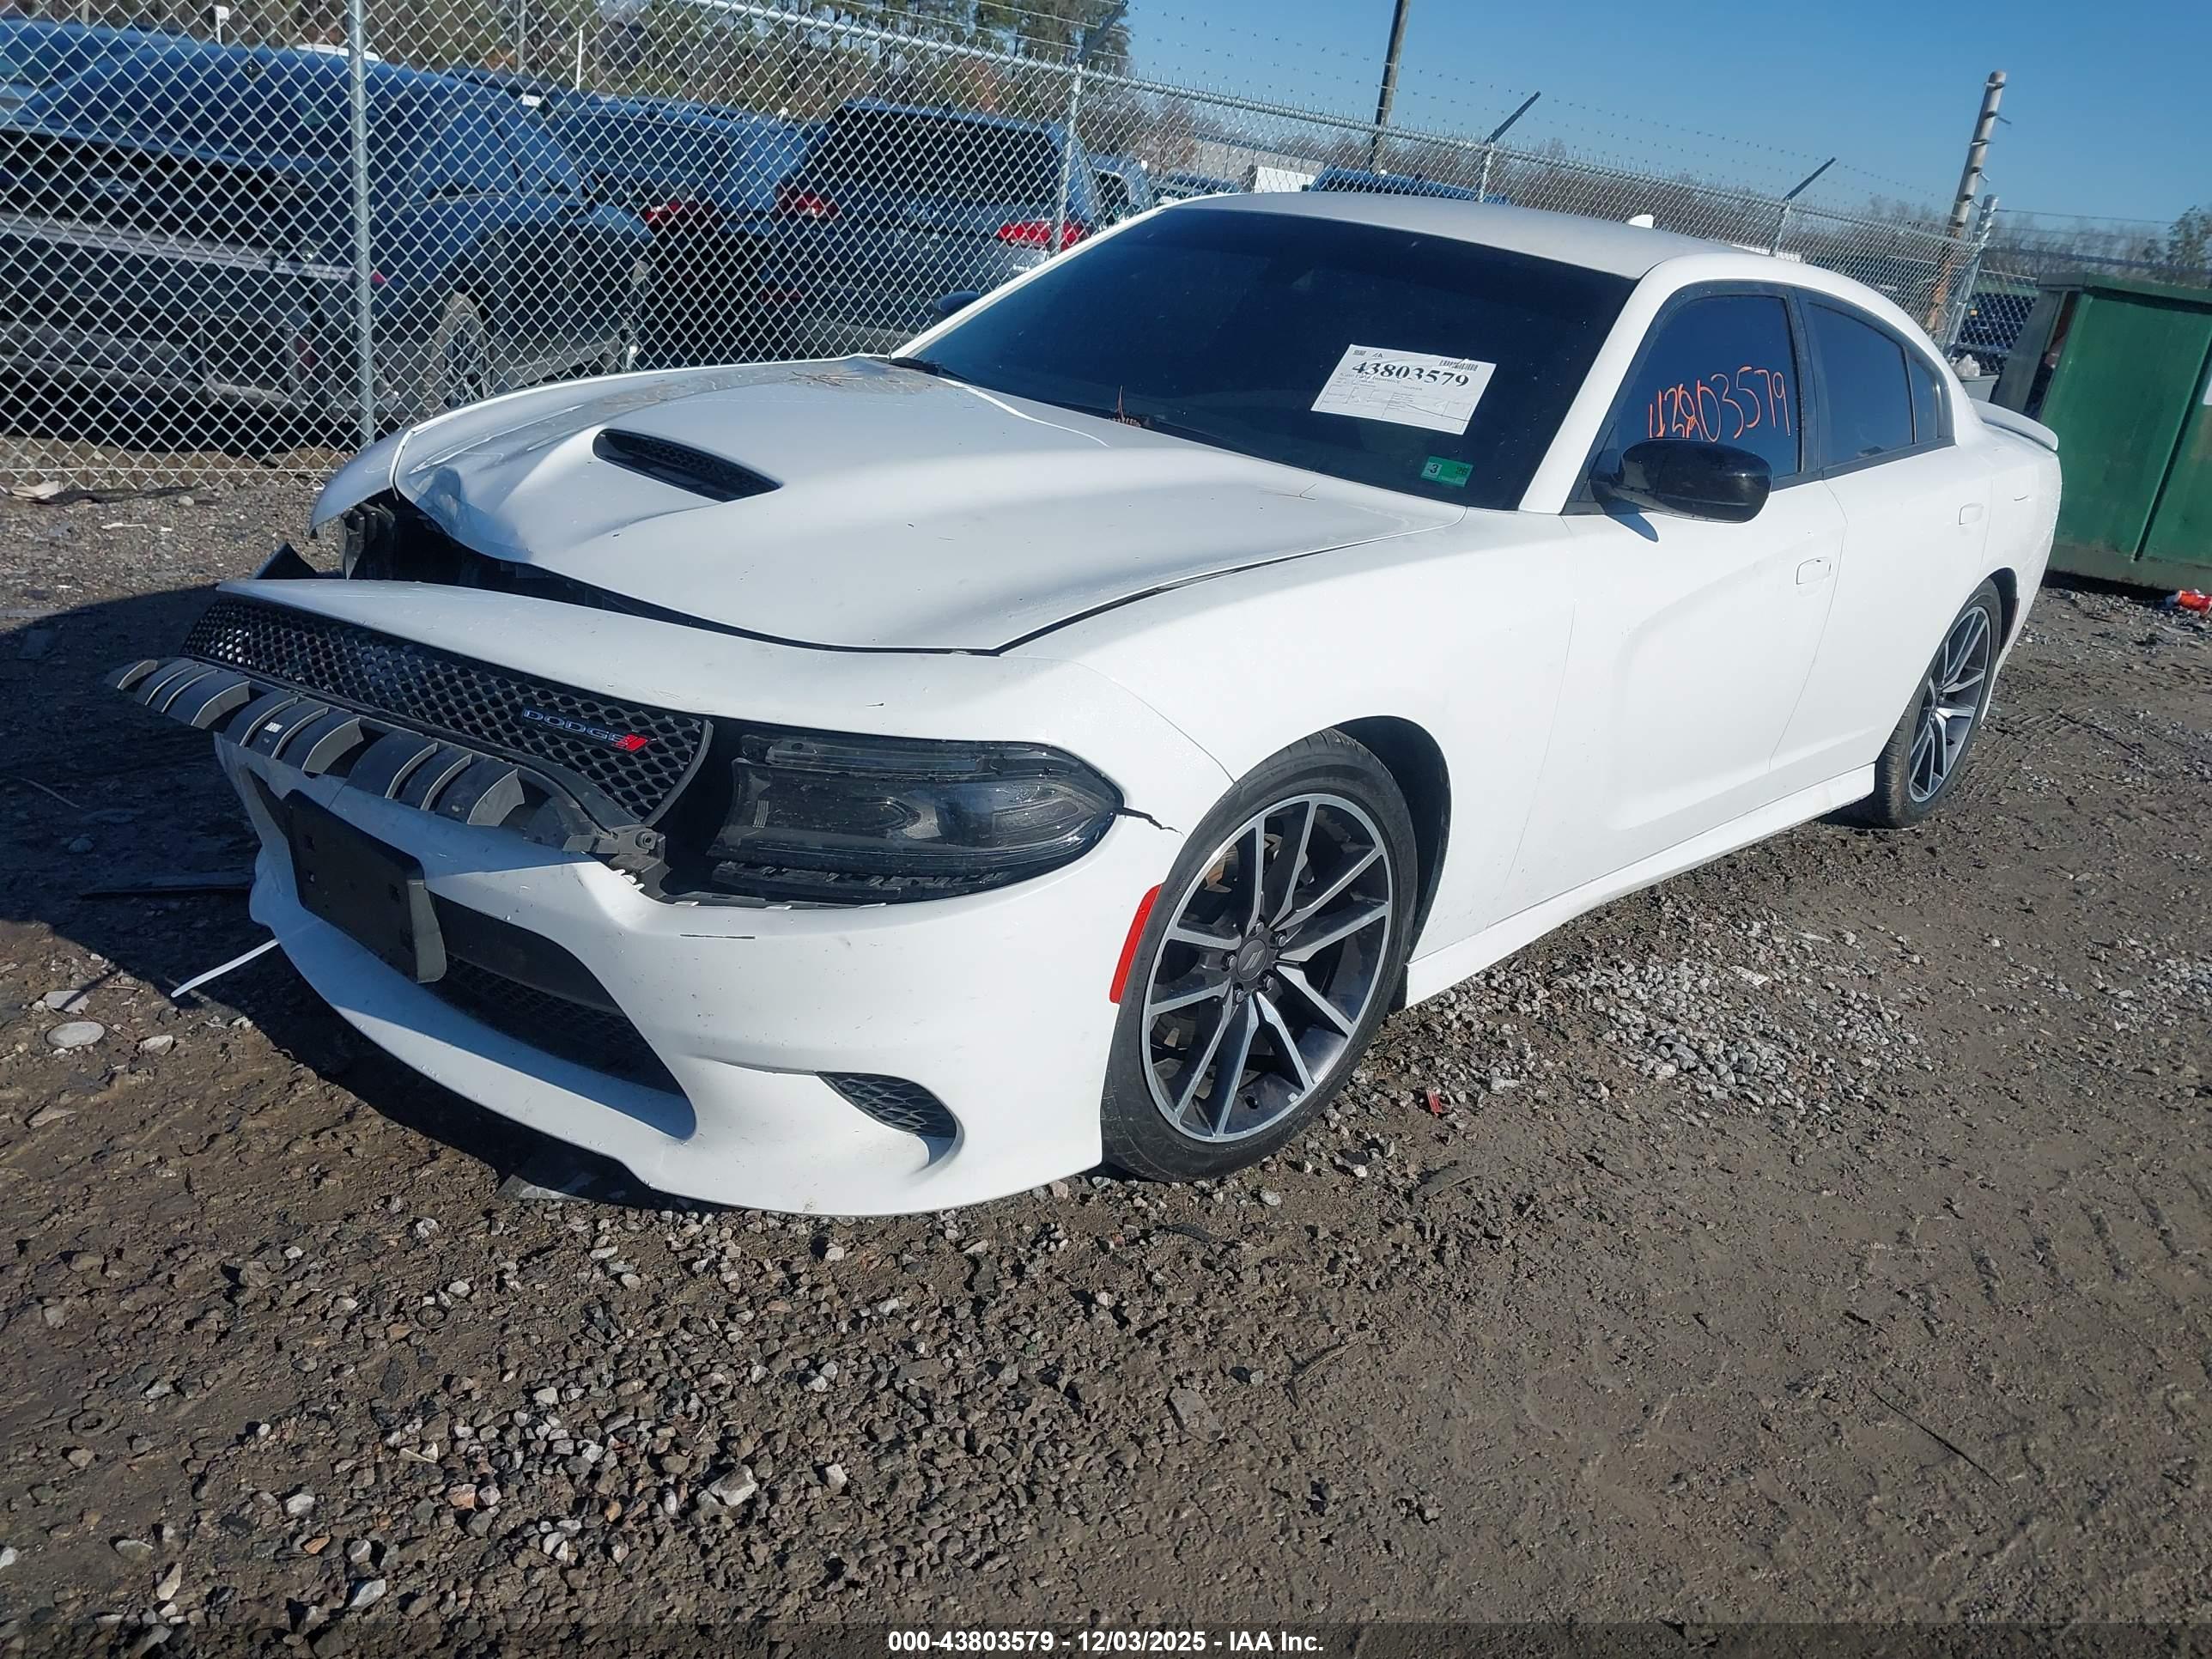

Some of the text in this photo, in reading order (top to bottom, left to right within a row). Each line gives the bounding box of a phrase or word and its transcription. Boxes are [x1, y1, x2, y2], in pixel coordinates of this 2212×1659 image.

[1352, 362, 1469, 387] 43803579
[1429, 464, 1438, 473] 3
[523, 709, 629, 745] DODGE
